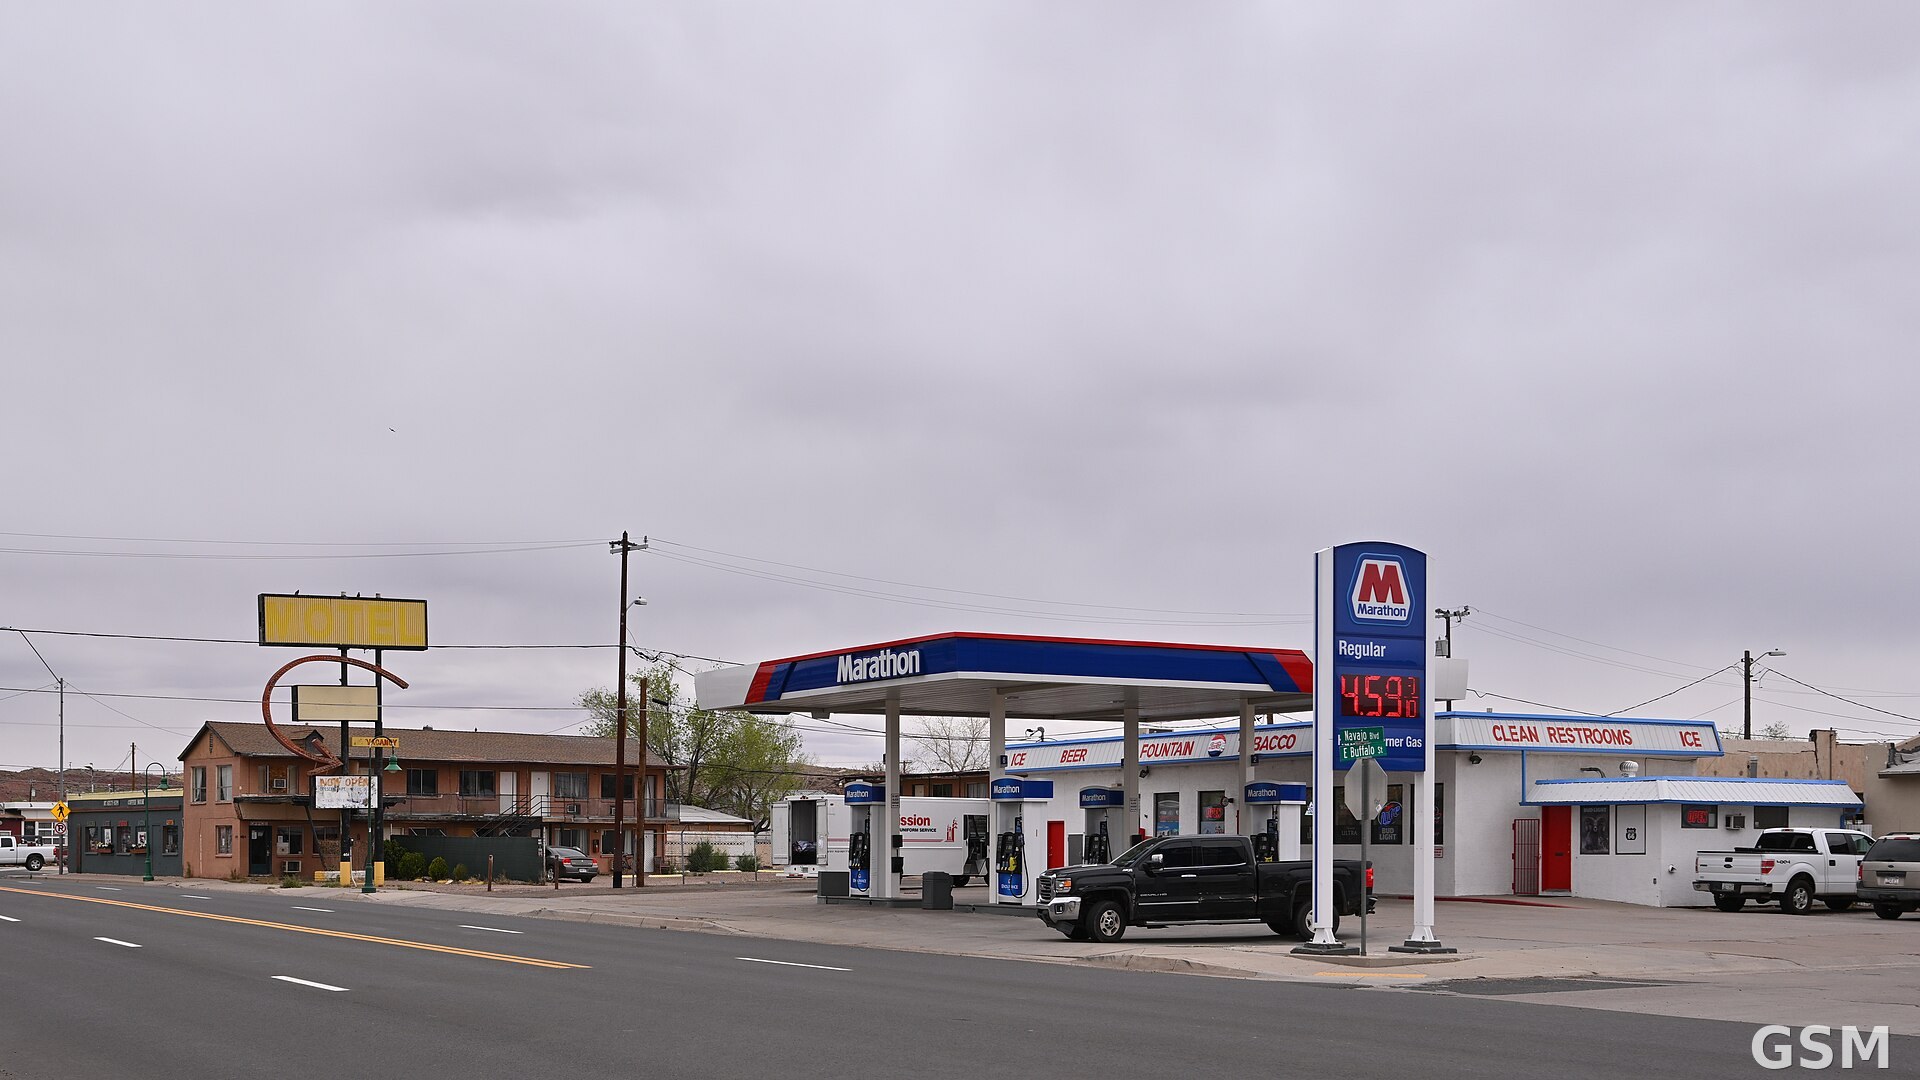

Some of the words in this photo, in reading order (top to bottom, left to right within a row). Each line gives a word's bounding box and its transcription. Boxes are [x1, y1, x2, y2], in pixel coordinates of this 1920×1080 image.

[1357, 603, 1406, 617] Marathon
[266, 601, 424, 645] MOTEL
[1338, 640, 1387, 660] Regular
[836, 648, 920, 683] Marathon
[1344, 729, 1367, 742] Navajo
[1370, 731, 1380, 740] Blvd
[1384, 737, 1404, 748] rner
[1405, 735, 1423, 748] Gas
[1492, 724, 1540, 743] CLEAN
[1546, 726, 1633, 746] RESTROOMS
[1679, 730, 1702, 748] ICE
[1010, 752, 1027, 767] ICE
[1060, 748, 1089, 764] BEER
[1139, 740, 1195, 759] FOUNTAIN
[1343, 747, 1348, 759] E
[1350, 744, 1375, 758] Buffalo
[1377, 745, 1385, 755] St
[345, 777, 368, 787] OPEN
[846, 789, 869, 799] Marathon
[993, 784, 1020, 795] Marathon
[1247, 788, 1277, 798] Marathon
[1081, 793, 1107, 803] Marathon
[899, 813, 931, 827] ssion
[1379, 833, 1398, 841] LIGHT
